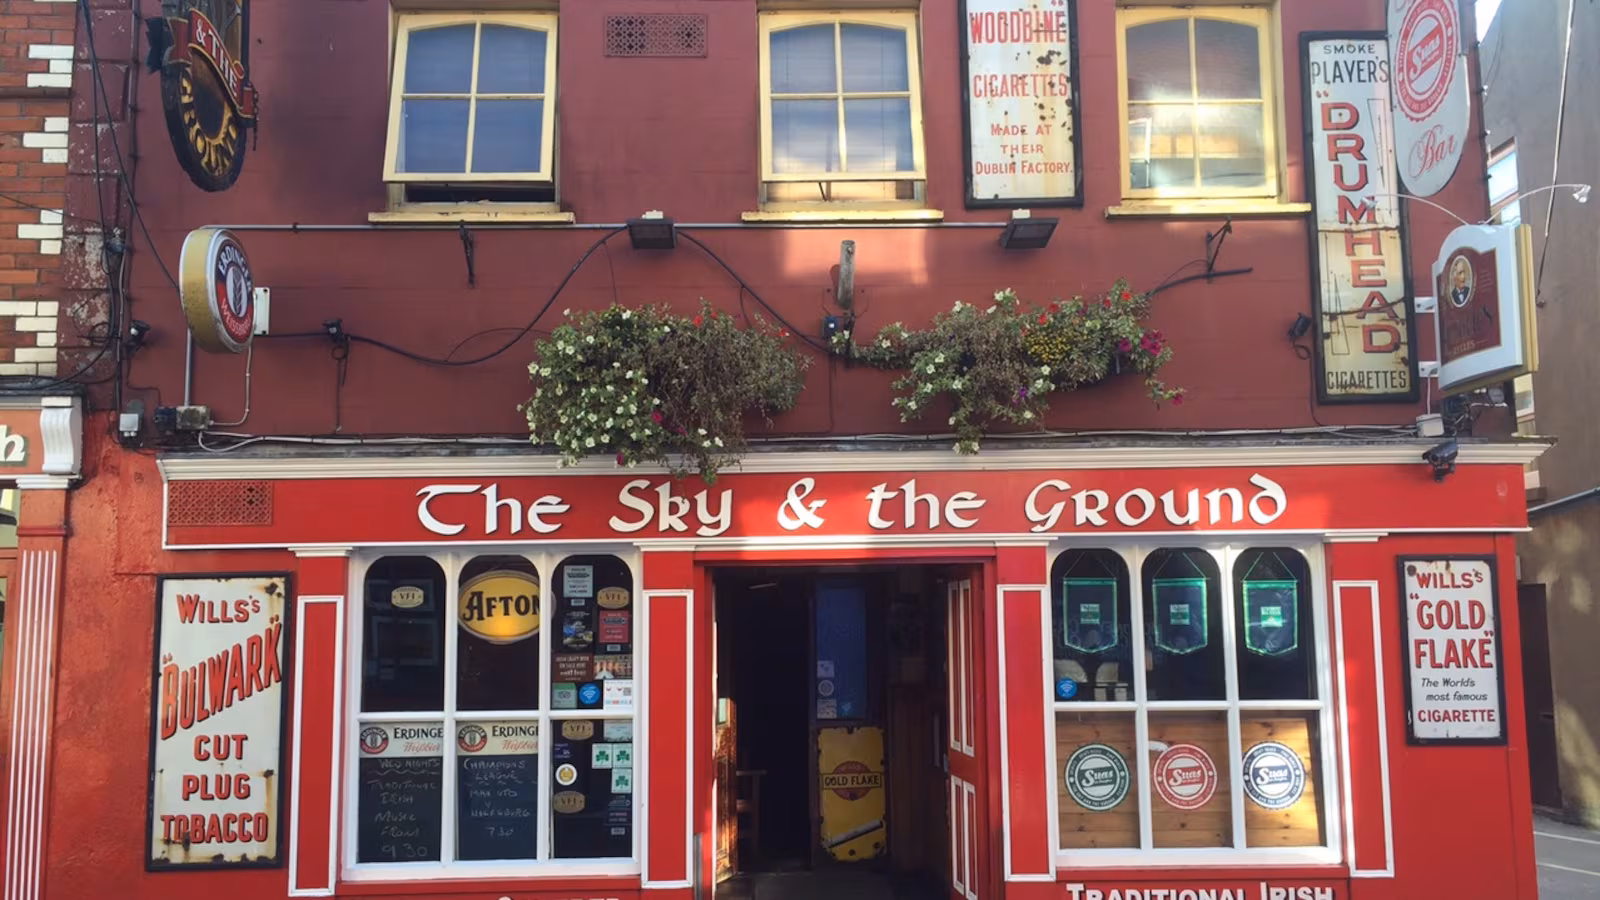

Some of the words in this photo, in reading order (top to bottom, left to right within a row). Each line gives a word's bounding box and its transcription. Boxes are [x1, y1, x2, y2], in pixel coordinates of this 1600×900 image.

[1323, 44, 1375, 54] SMOKE
[196, 19, 206, 46] &
[208, 29, 240, 98] THE
[1311, 57, 1390, 85] PLAYER'S
[973, 74, 1068, 98] CIGARETTES
[991, 124, 1028, 136] MADE
[1035, 125, 1052, 136] AT
[1000, 145, 1044, 154] THEIR
[1408, 124, 1457, 180] Bar
[976, 161, 1016, 175] DUBLIN
[1327, 370, 1407, 389] CIGARETTES
[416, 482, 571, 536] The
[608, 479, 733, 537] Sky
[777, 477, 828, 530] &
[865, 478, 987, 529] the
[1421, 678, 1439, 688] The
[1426, 692, 1451, 701] most
[1453, 691, 1488, 702] famous
[1418, 709, 1496, 723] CIGARETTE
[194, 734, 248, 761] CUT
[824, 776, 848, 787] GOLD
[851, 775, 879, 786] FLAKE
[1081, 769, 1114, 787] Suas
[1168, 768, 1202, 786] Suas
[1256, 767, 1288, 785] Suas
[182, 773, 250, 800] PLUG
[160, 812, 268, 843] TOBACCO
